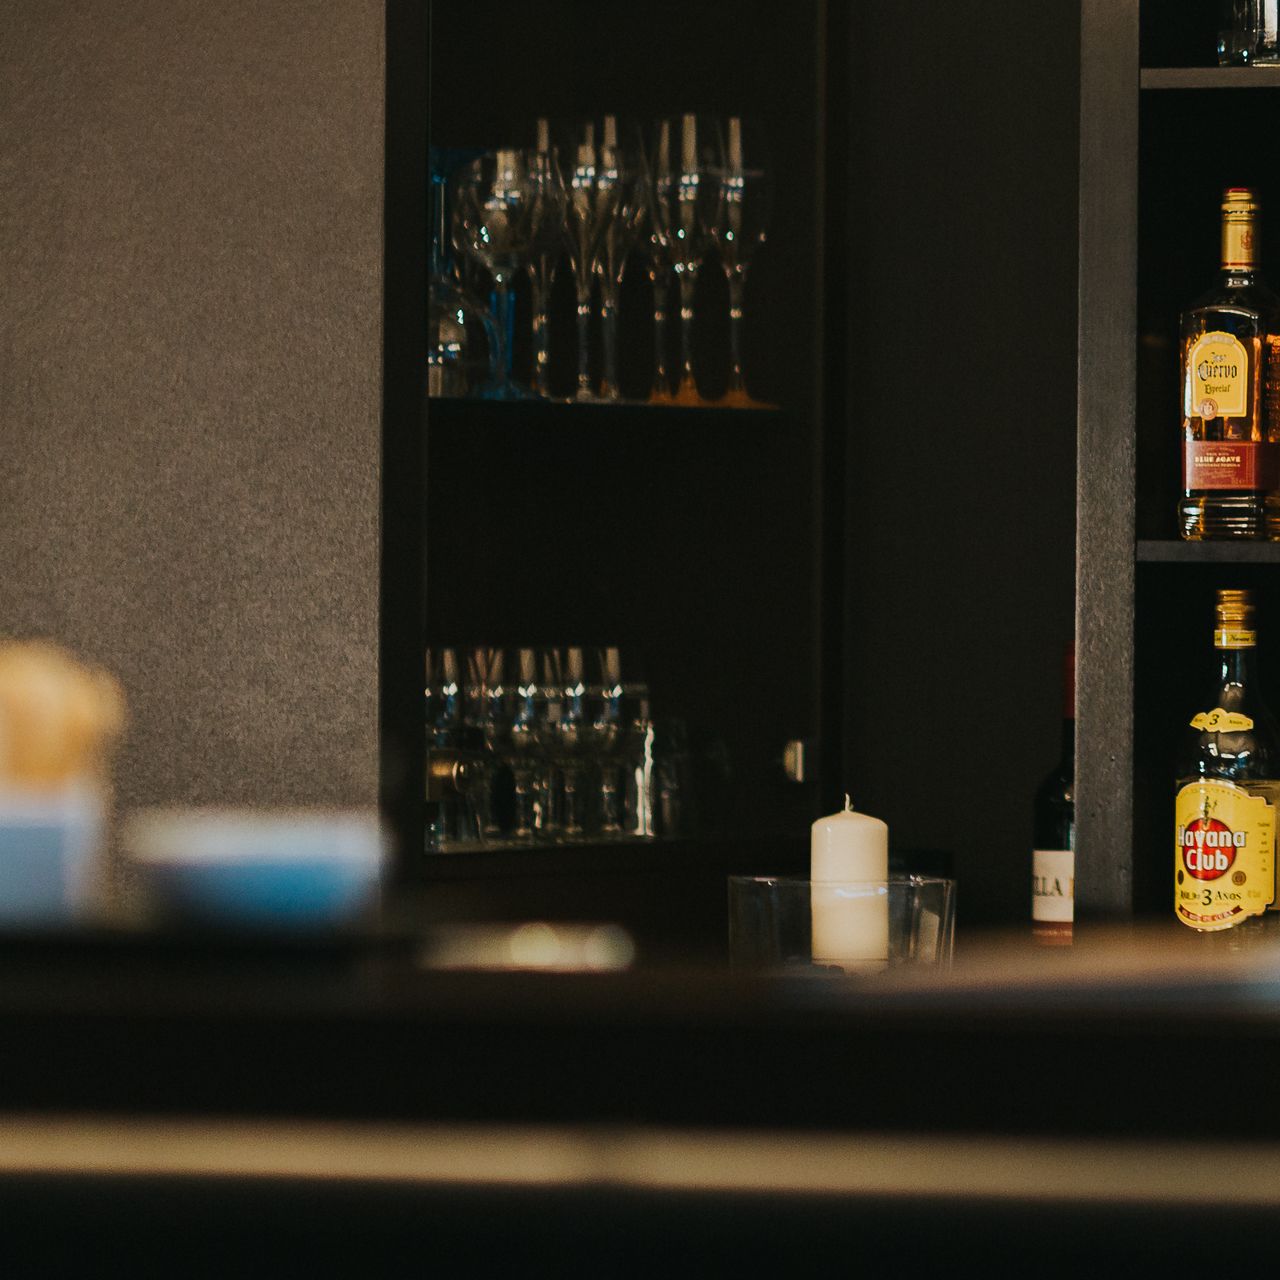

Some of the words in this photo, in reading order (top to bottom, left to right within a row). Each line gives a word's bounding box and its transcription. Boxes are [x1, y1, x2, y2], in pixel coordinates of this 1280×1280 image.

[1198, 360, 1238, 382] Cuervo
[1209, 714, 1219, 725] 3
[1178, 824, 1246, 848] Havana
[1186, 848, 1228, 871] Club
[1202, 889, 1212, 905] 3
